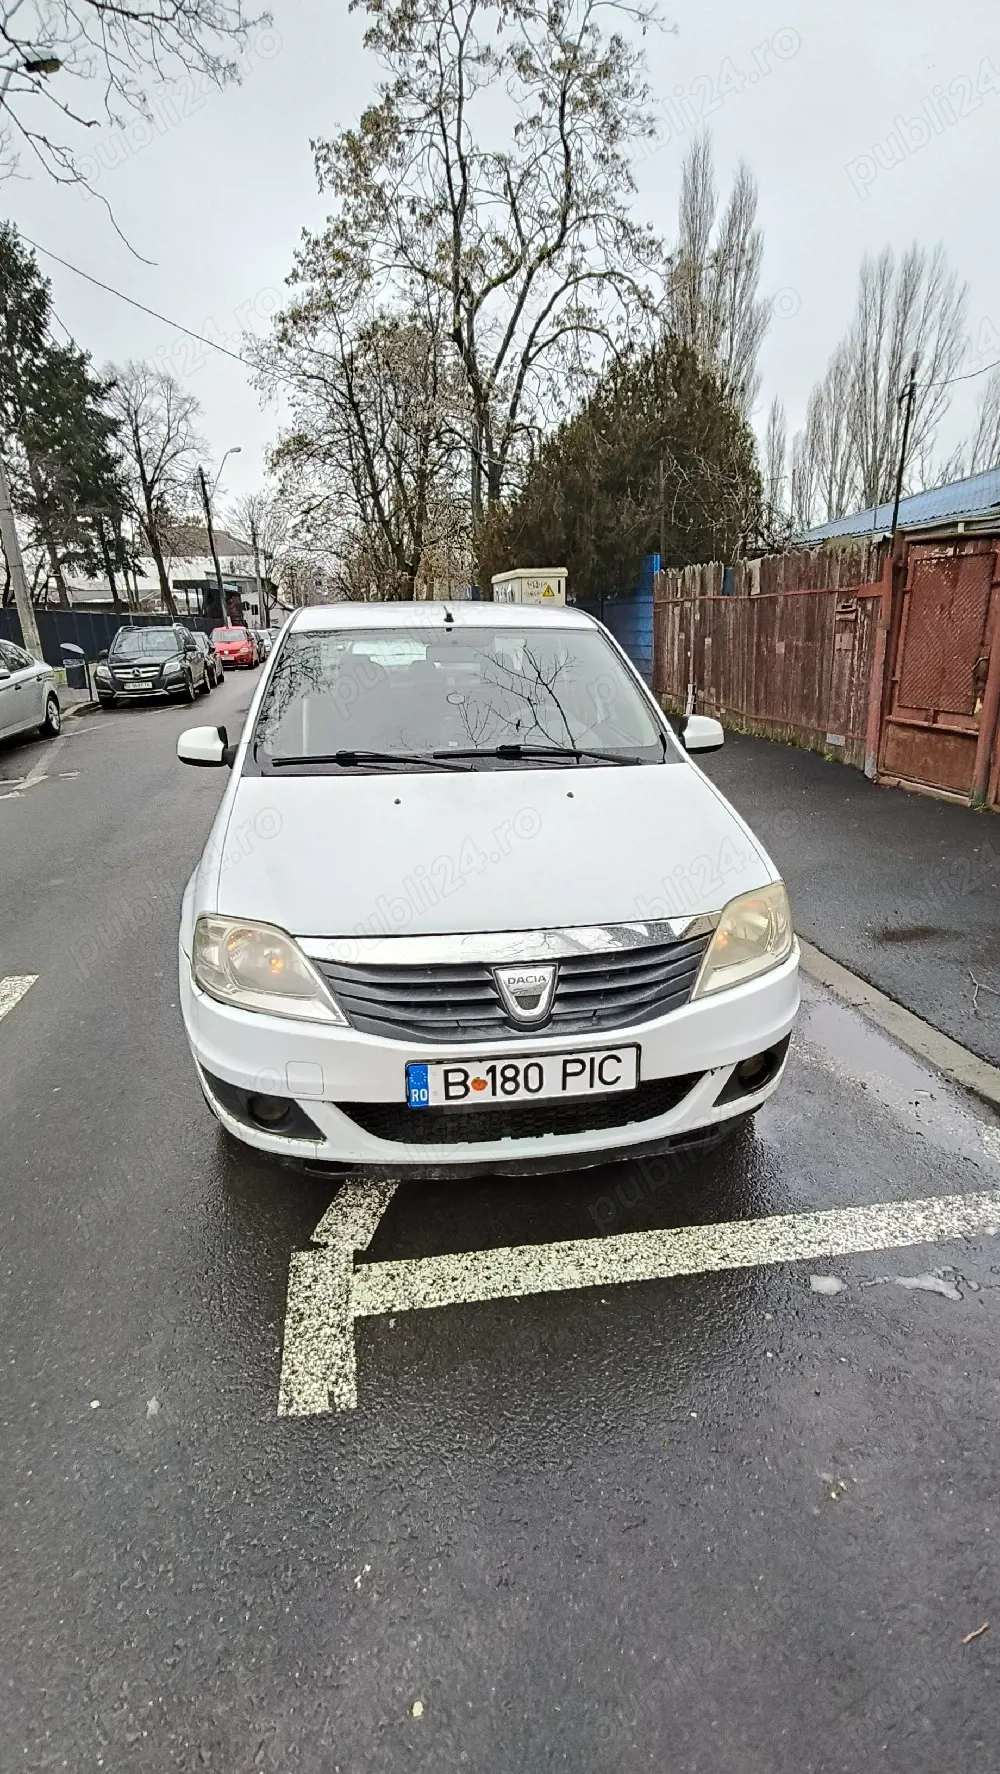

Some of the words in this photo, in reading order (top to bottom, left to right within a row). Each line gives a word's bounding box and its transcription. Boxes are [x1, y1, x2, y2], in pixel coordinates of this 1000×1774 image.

[508, 975, 547, 985] DACIA
[443, 1068, 470, 1101] B
[486, 1062, 544, 1097] 180
[562, 1054, 622, 1091] PIC
[411, 1088, 428, 1102] RO
